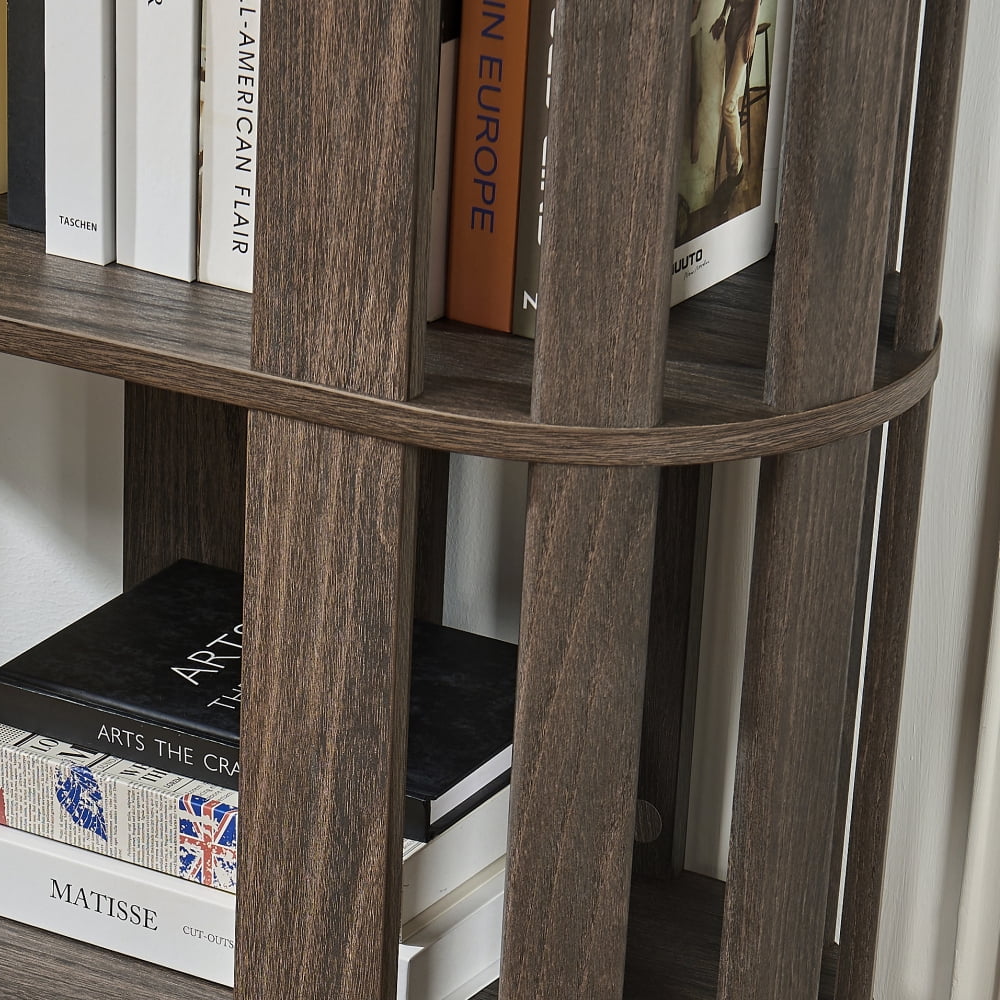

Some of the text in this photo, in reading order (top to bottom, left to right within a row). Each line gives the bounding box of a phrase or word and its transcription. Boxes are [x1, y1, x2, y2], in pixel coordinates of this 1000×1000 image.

[232, 0, 256, 254] L-AMERICAN FLAIR
[471, 0, 506, 234] IN EUROPE
[59, 215, 98, 232] TASCHEN
[672, 249, 703, 276] UUTO
[206, 683, 242, 710] TH
[97, 724, 146, 752] ARTS
[154, 738, 194, 766] THE
[50, 878, 159, 932] MATISSE
[182, 925, 234, 949] CUT-OUTS
